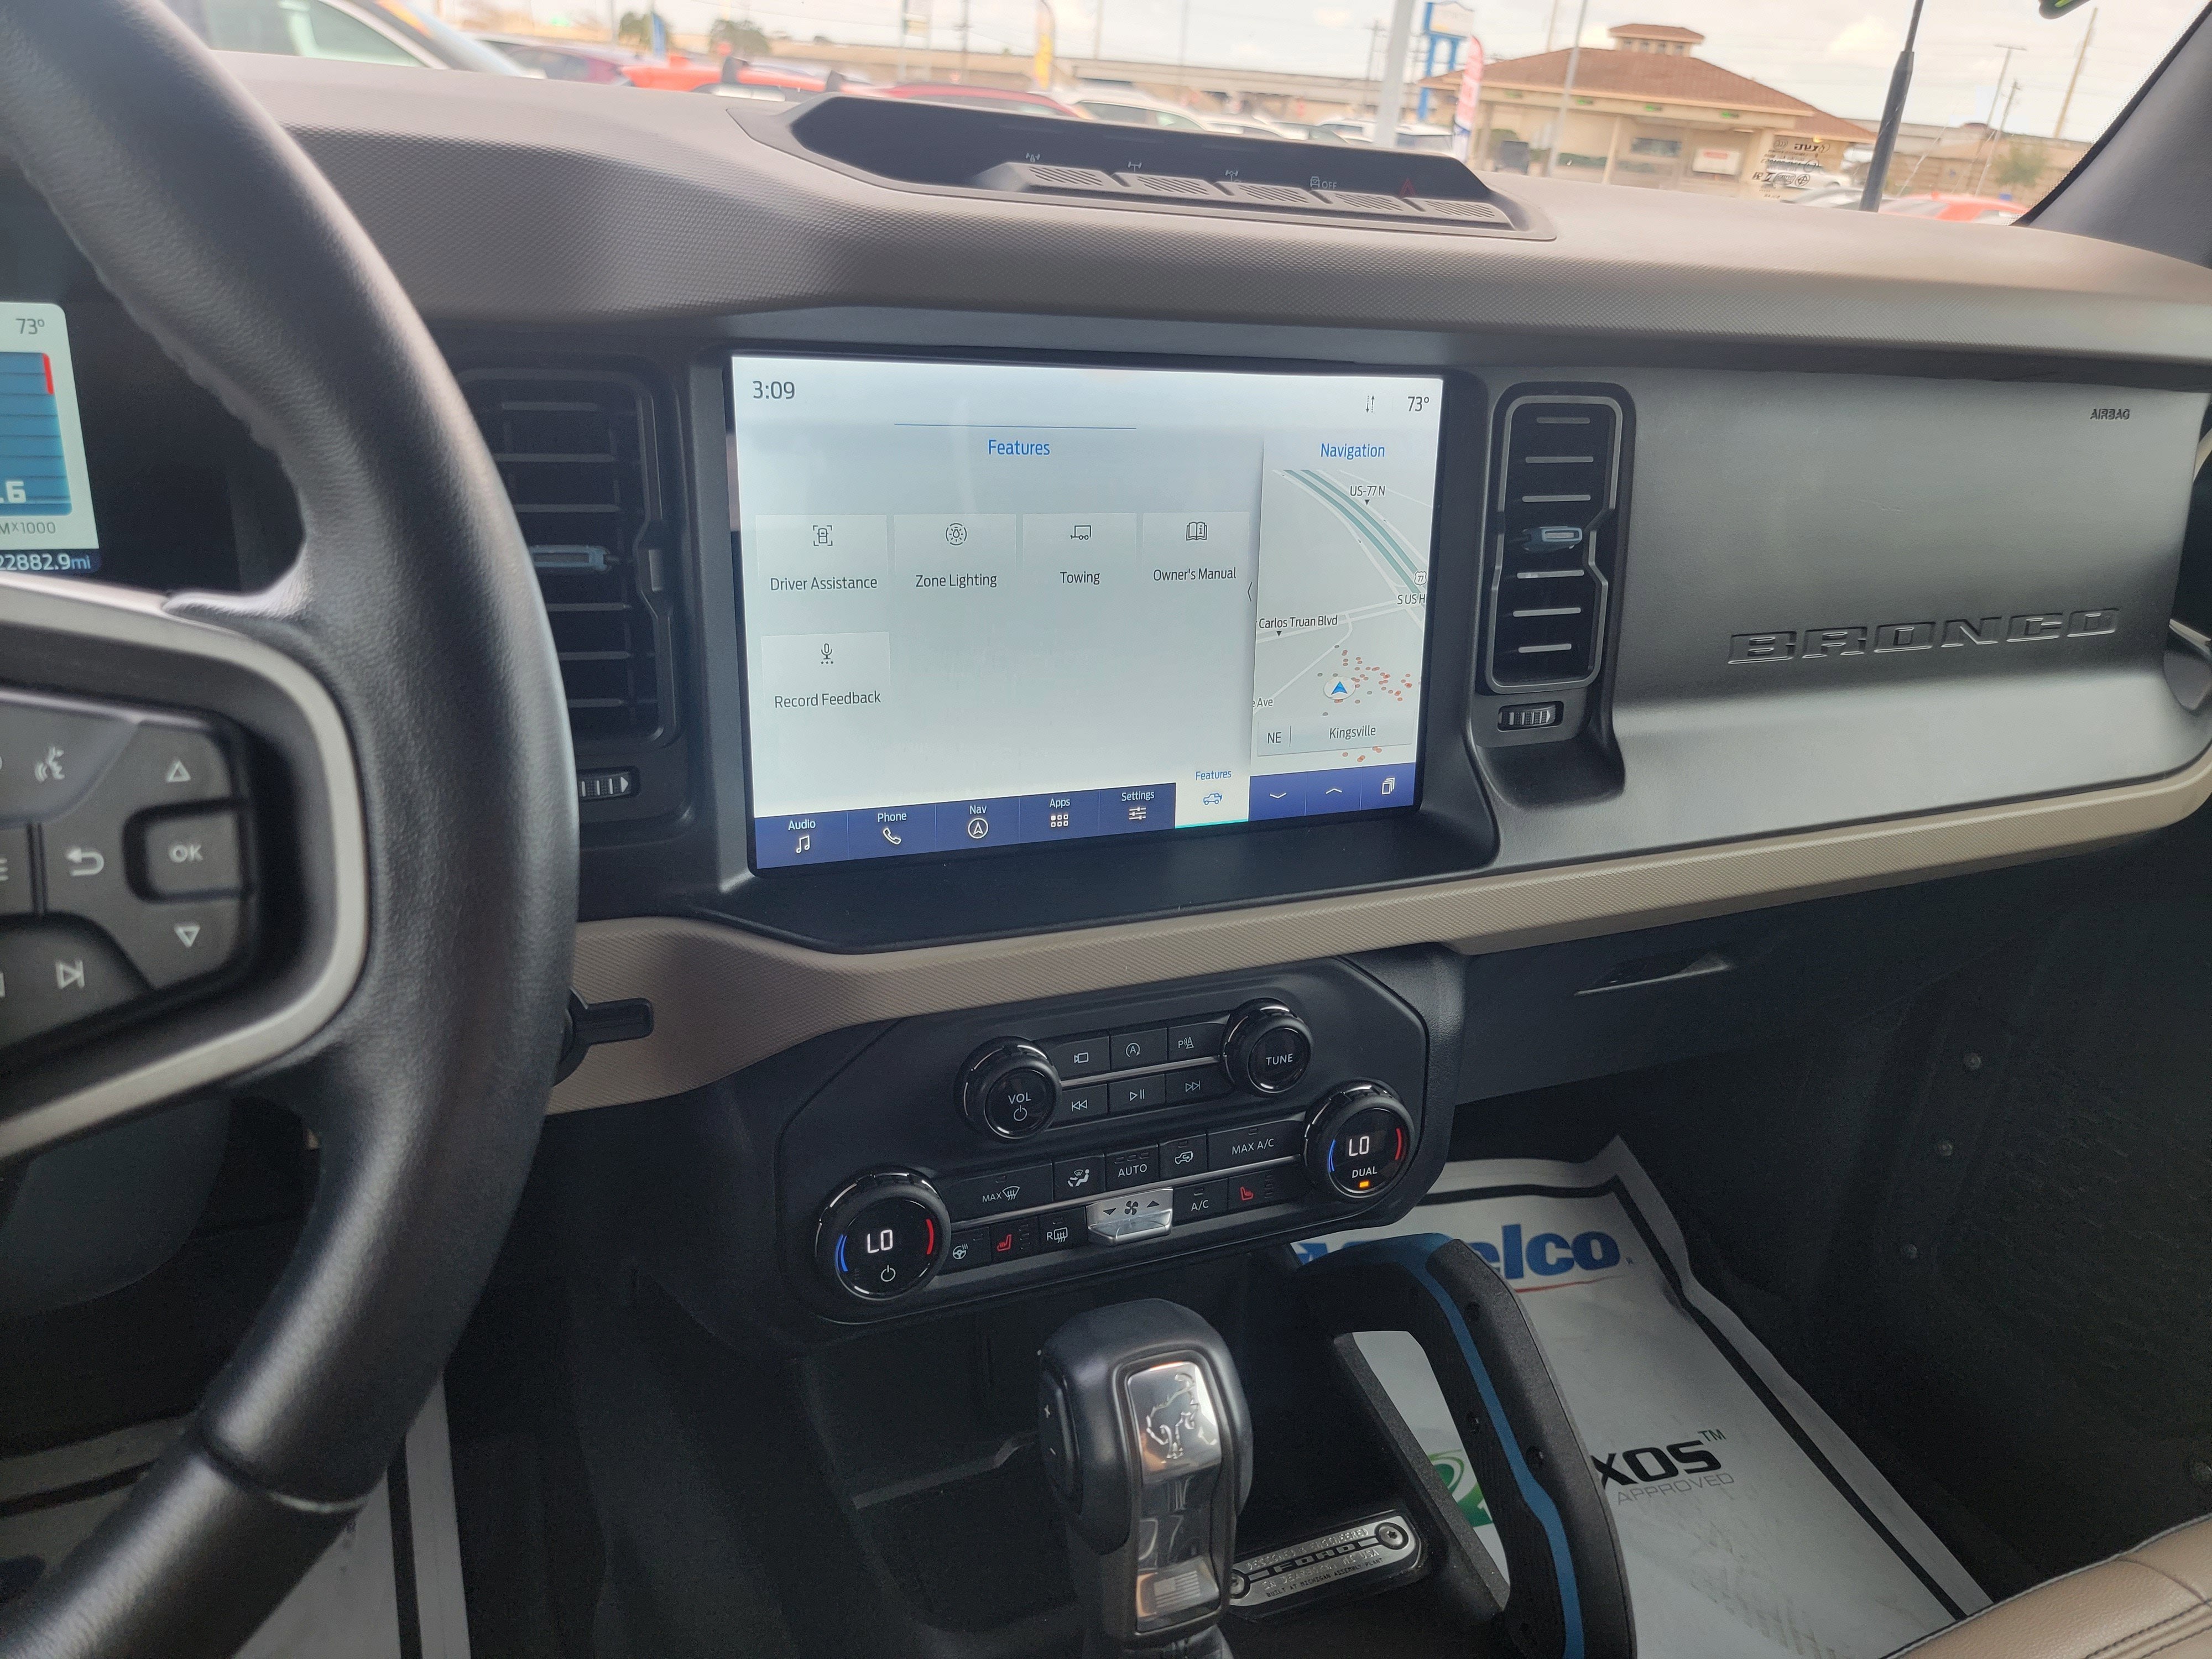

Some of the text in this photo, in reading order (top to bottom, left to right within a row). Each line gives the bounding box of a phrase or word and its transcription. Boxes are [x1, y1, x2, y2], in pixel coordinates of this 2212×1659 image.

[753, 380, 795, 400] 3:09
[1407, 397, 1430, 412] 73°
[2090, 409, 2130, 420] AIRBAG
[988, 439, 1050, 456] Features
[1321, 444, 1385, 460] Navigation
[916, 572, 997, 588] Zone Lighting
[1060, 571, 1100, 586] Towing
[1153, 567, 1237, 582] Owner's Manual
[770, 576, 878, 591] Driver Assistance
[1259, 615, 1338, 628] Carlos Truan Blvd
[1728, 608, 2120, 664] BRONCO
[775, 691, 881, 708] Record Feedback
[1257, 698, 1273, 707] Ave
[1267, 732, 1282, 744] NE
[1329, 725, 1376, 740] Kingsville
[1196, 769, 1232, 780] Features
[1121, 790, 1155, 802] Settings
[969, 805, 988, 815] Nav
[1049, 798, 1071, 810] Apps
[788, 819, 816, 831] Audio
[877, 812, 907, 823] Phone
[169, 844, 204, 863] OK
[1266, 1053, 1293, 1066] TUNE
[1008, 1092, 1032, 1104] VOL
[1232, 1138, 1274, 1154] MAX A/C
[1118, 1163, 1147, 1178] AUTO
[1352, 1166, 1378, 1178] DUAL
[982, 1192, 1002, 1203] MAX
[1191, 1199, 1209, 1212] A/C
[1618, 1473, 1735, 1505] APPROVED
[1246, 1549, 1296, 1570] DESIGNED
[1309, 1528, 1369, 1550] ENGINEERED
[1359, 1548, 1380, 1559] USA
[1274, 1543, 1355, 1573] FORD
[1266, 1587, 1285, 1598] BUILT
[1300, 1574, 1331, 1588] MICHIGAN
[1334, 1564, 1362, 1577] ASSEMBLY
[1365, 1558, 1383, 1567] PLANT
